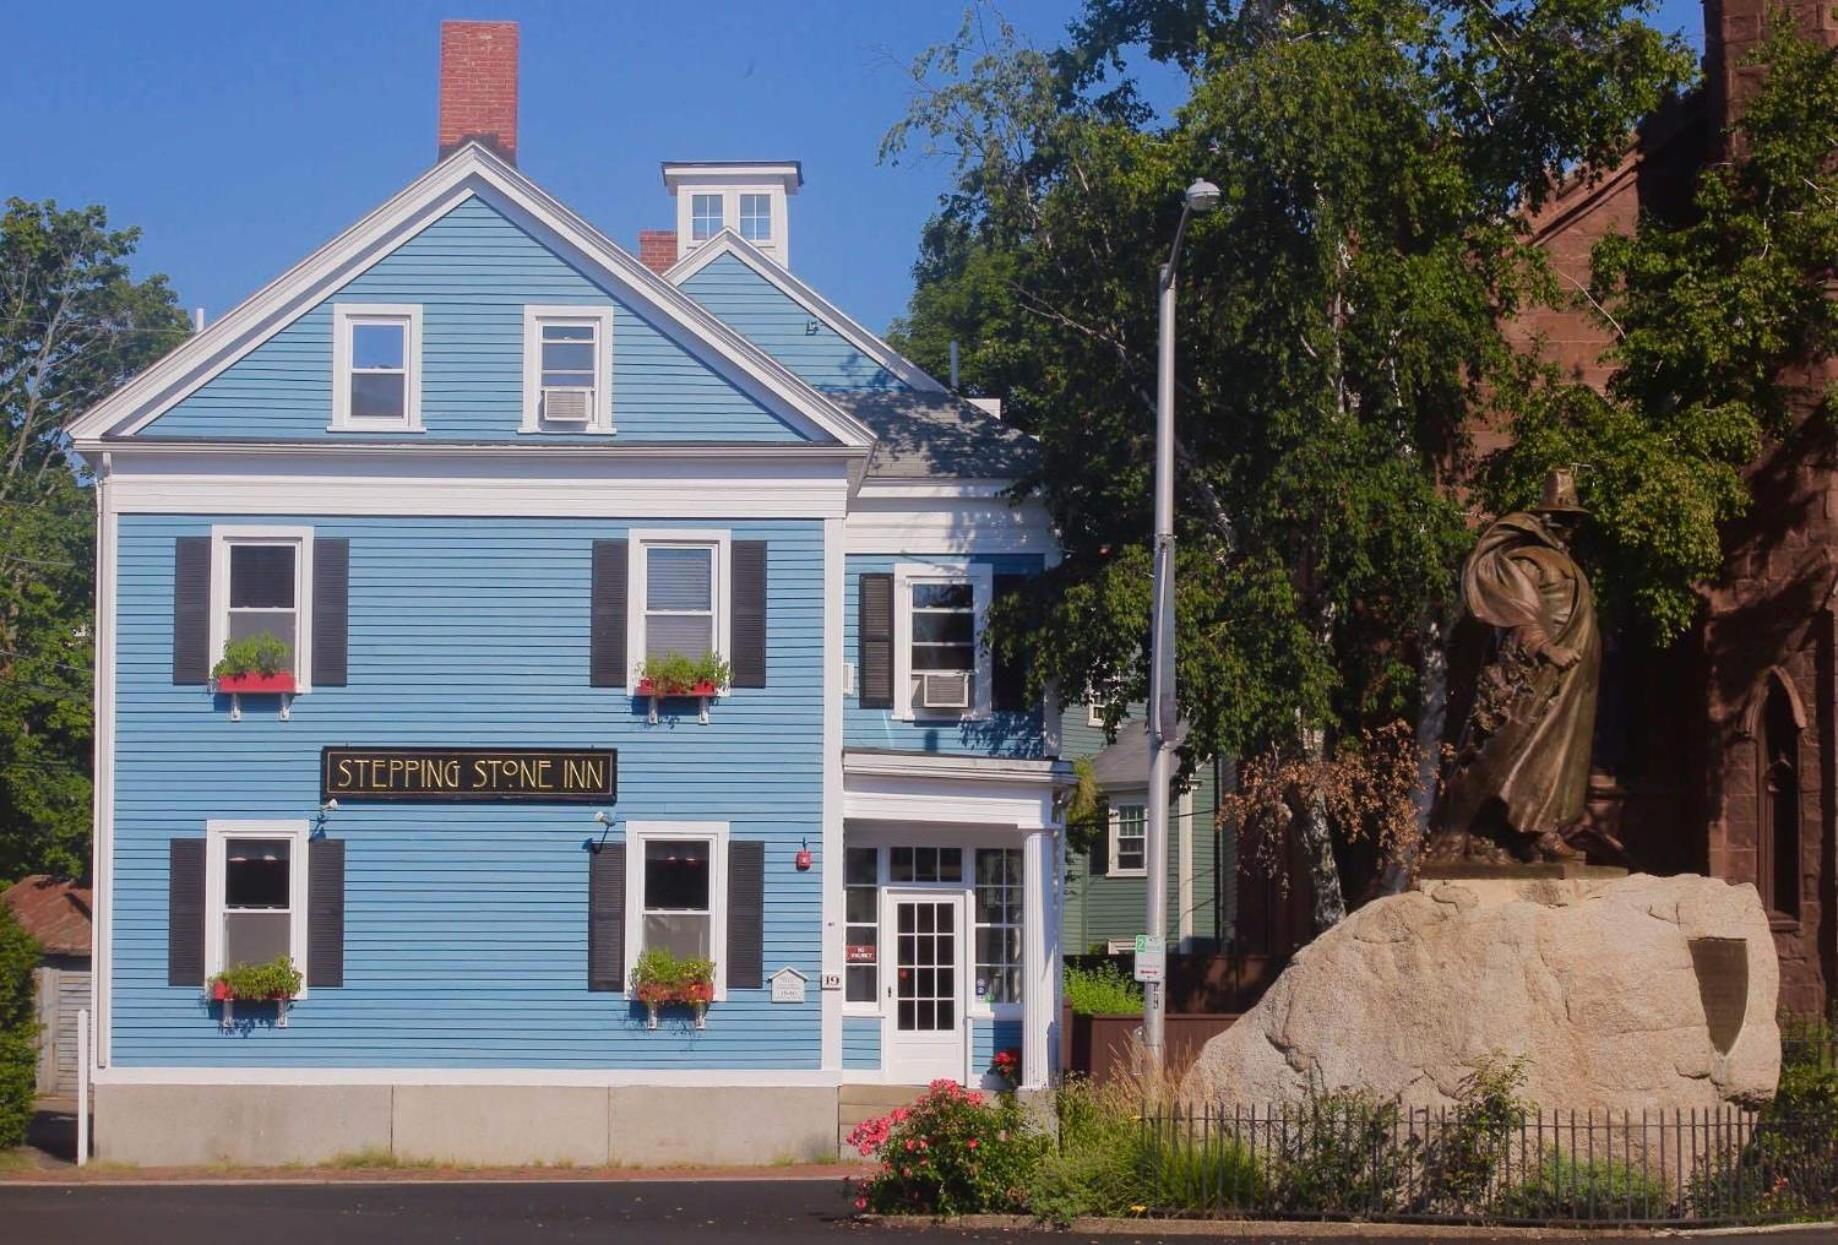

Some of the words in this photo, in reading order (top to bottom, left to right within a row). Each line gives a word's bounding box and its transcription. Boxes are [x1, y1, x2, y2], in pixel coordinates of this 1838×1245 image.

[337, 759, 461, 788] STEPPING
[472, 760, 553, 789] STONE
[563, 760, 603, 789] INN
[825, 975, 840, 986] 19
